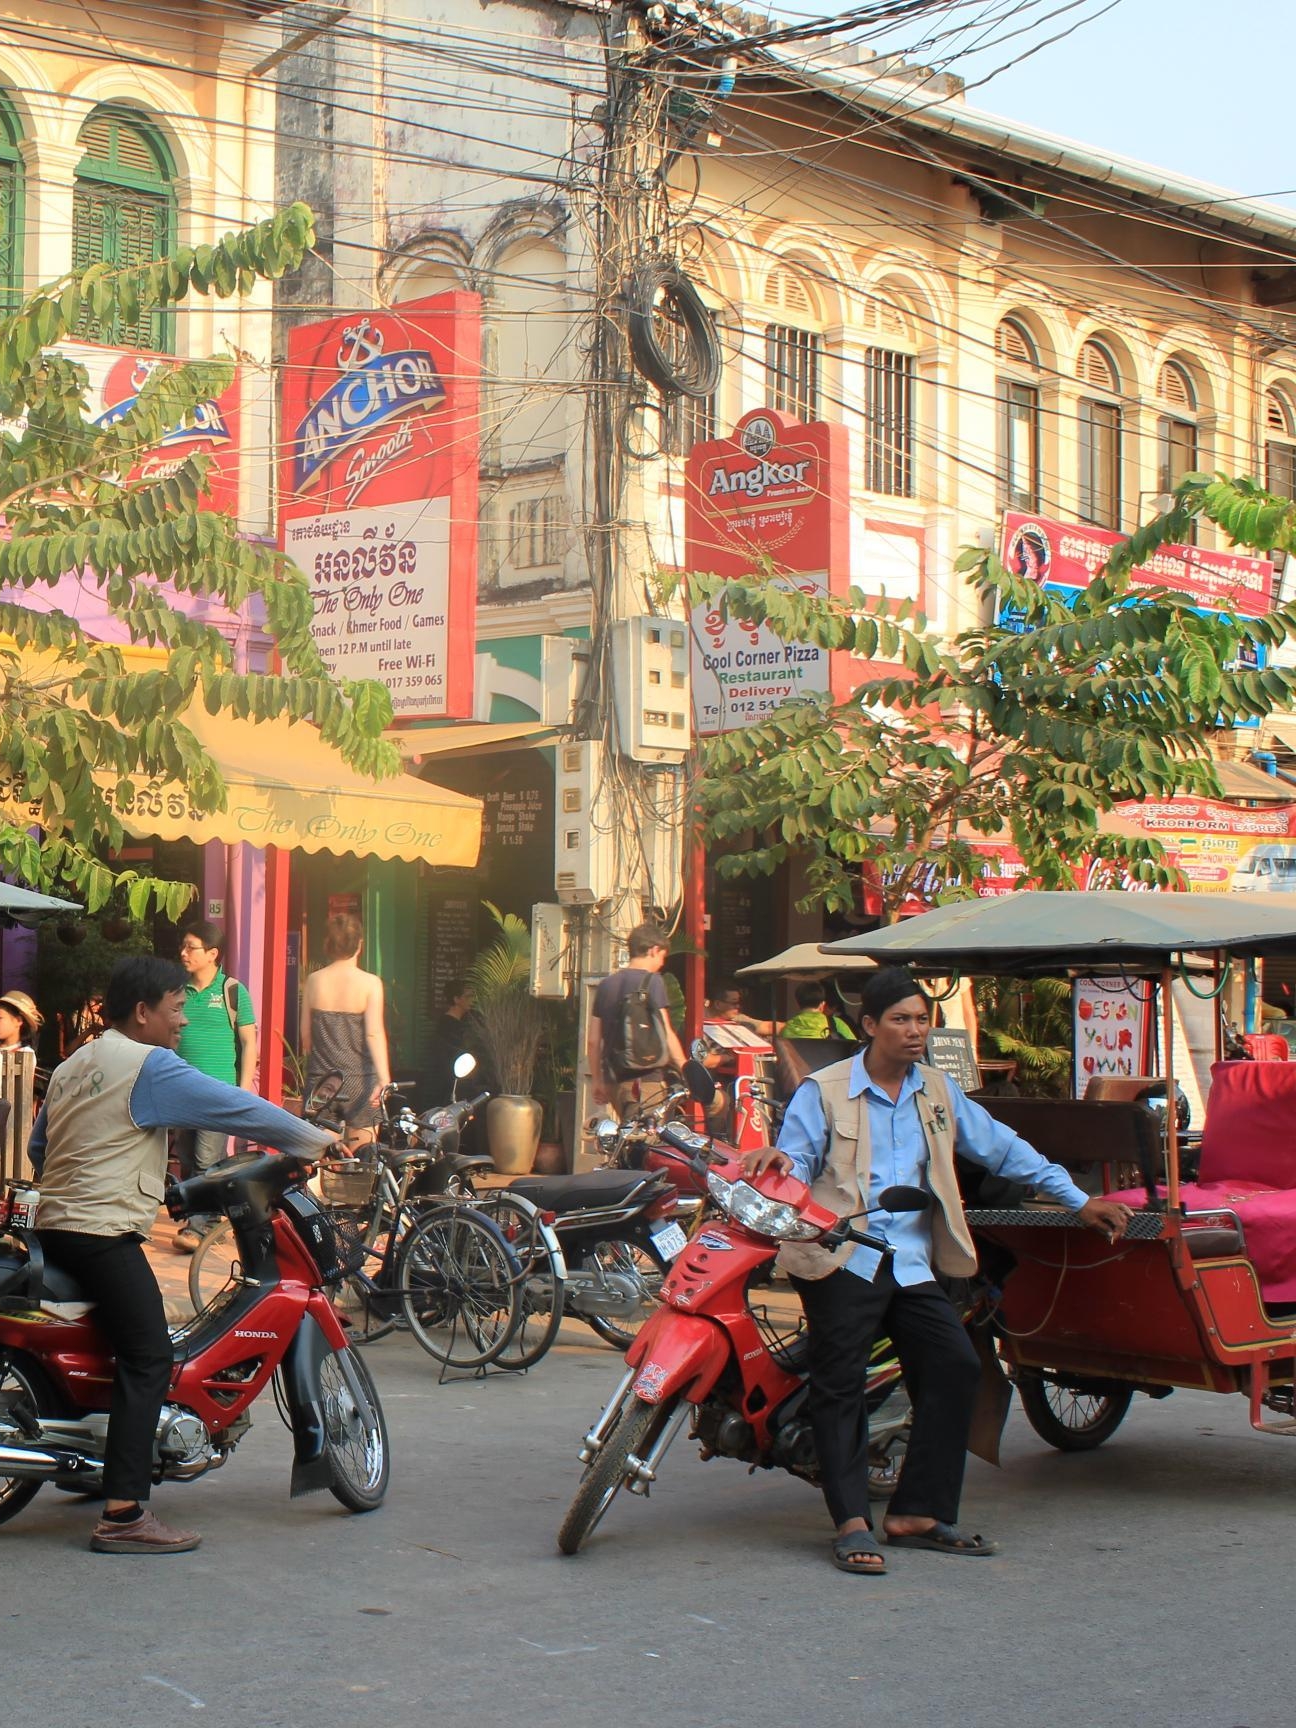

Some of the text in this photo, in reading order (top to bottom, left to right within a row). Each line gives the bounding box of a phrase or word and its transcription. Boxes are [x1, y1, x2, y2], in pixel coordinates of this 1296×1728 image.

[304, 357, 438, 473] ANCHOR
[345, 417, 414, 507] Smooth
[709, 460, 811, 498] Angkor
[343, 584, 383, 617] Only
[388, 580, 425, 608] One
[310, 623, 336, 638] Snack
[346, 619, 377, 636] Khmer
[379, 615, 402, 632] Food
[412, 614, 445, 629] Games
[316, 637, 412, 658] pen 12 P.M until late
[703, 645, 820, 671] Cool Corner Pizza
[378, 653, 436, 672] Free Wi-Fi
[386, 674, 443, 689] 017 359 065
[720, 665, 803, 685] Restaurant
[729, 685, 792, 699] Delivery
[731, 701, 755, 714] 012
[232, 805, 442, 849] The Only One
[1232, 823, 1289, 834] EXPRESS
[234, 1330, 279, 1340] HONDA
